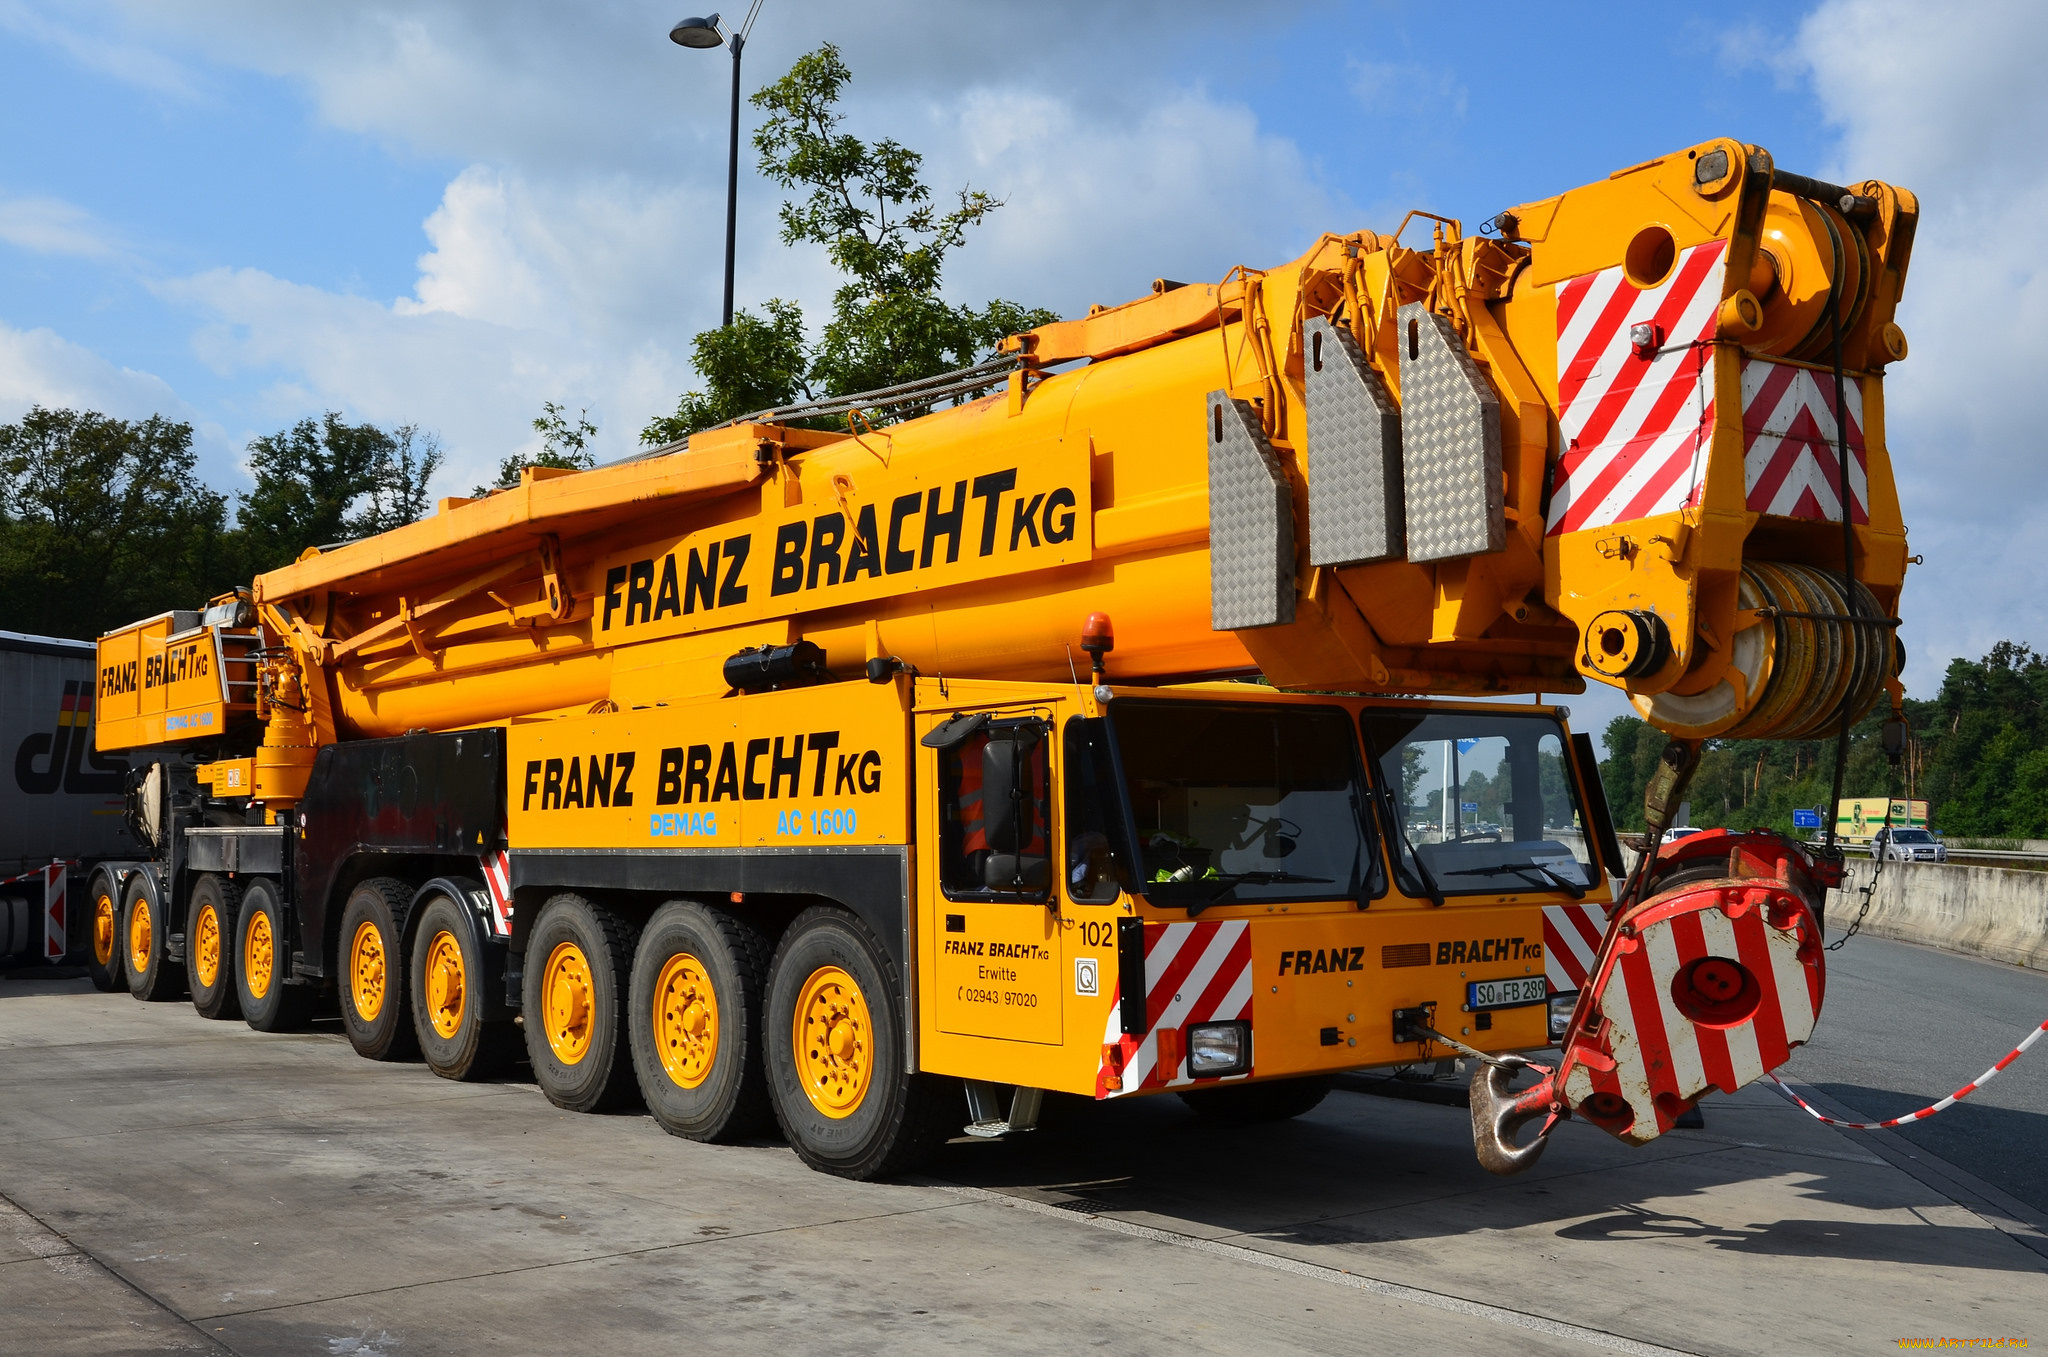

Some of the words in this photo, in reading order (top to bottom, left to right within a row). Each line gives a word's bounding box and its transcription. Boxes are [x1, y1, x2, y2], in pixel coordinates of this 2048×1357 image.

[602, 534, 751, 631] FRANZ
[100, 661, 137, 698] FRANZ
[522, 751, 636, 811] FRANZ
[650, 812, 717, 836] DEMAG
[776, 809, 802, 836] AC
[809, 807, 857, 835] 1600
[1079, 921, 1113, 947] 102
[945, 940, 985, 956] FRANZ
[1278, 946, 1365, 976] FRANZ
[978, 965, 1017, 981] Erwitte
[1477, 984, 1495, 1004] SO
[1503, 982, 1520, 1002] FB
[1522, 980, 1545, 1000] 289
